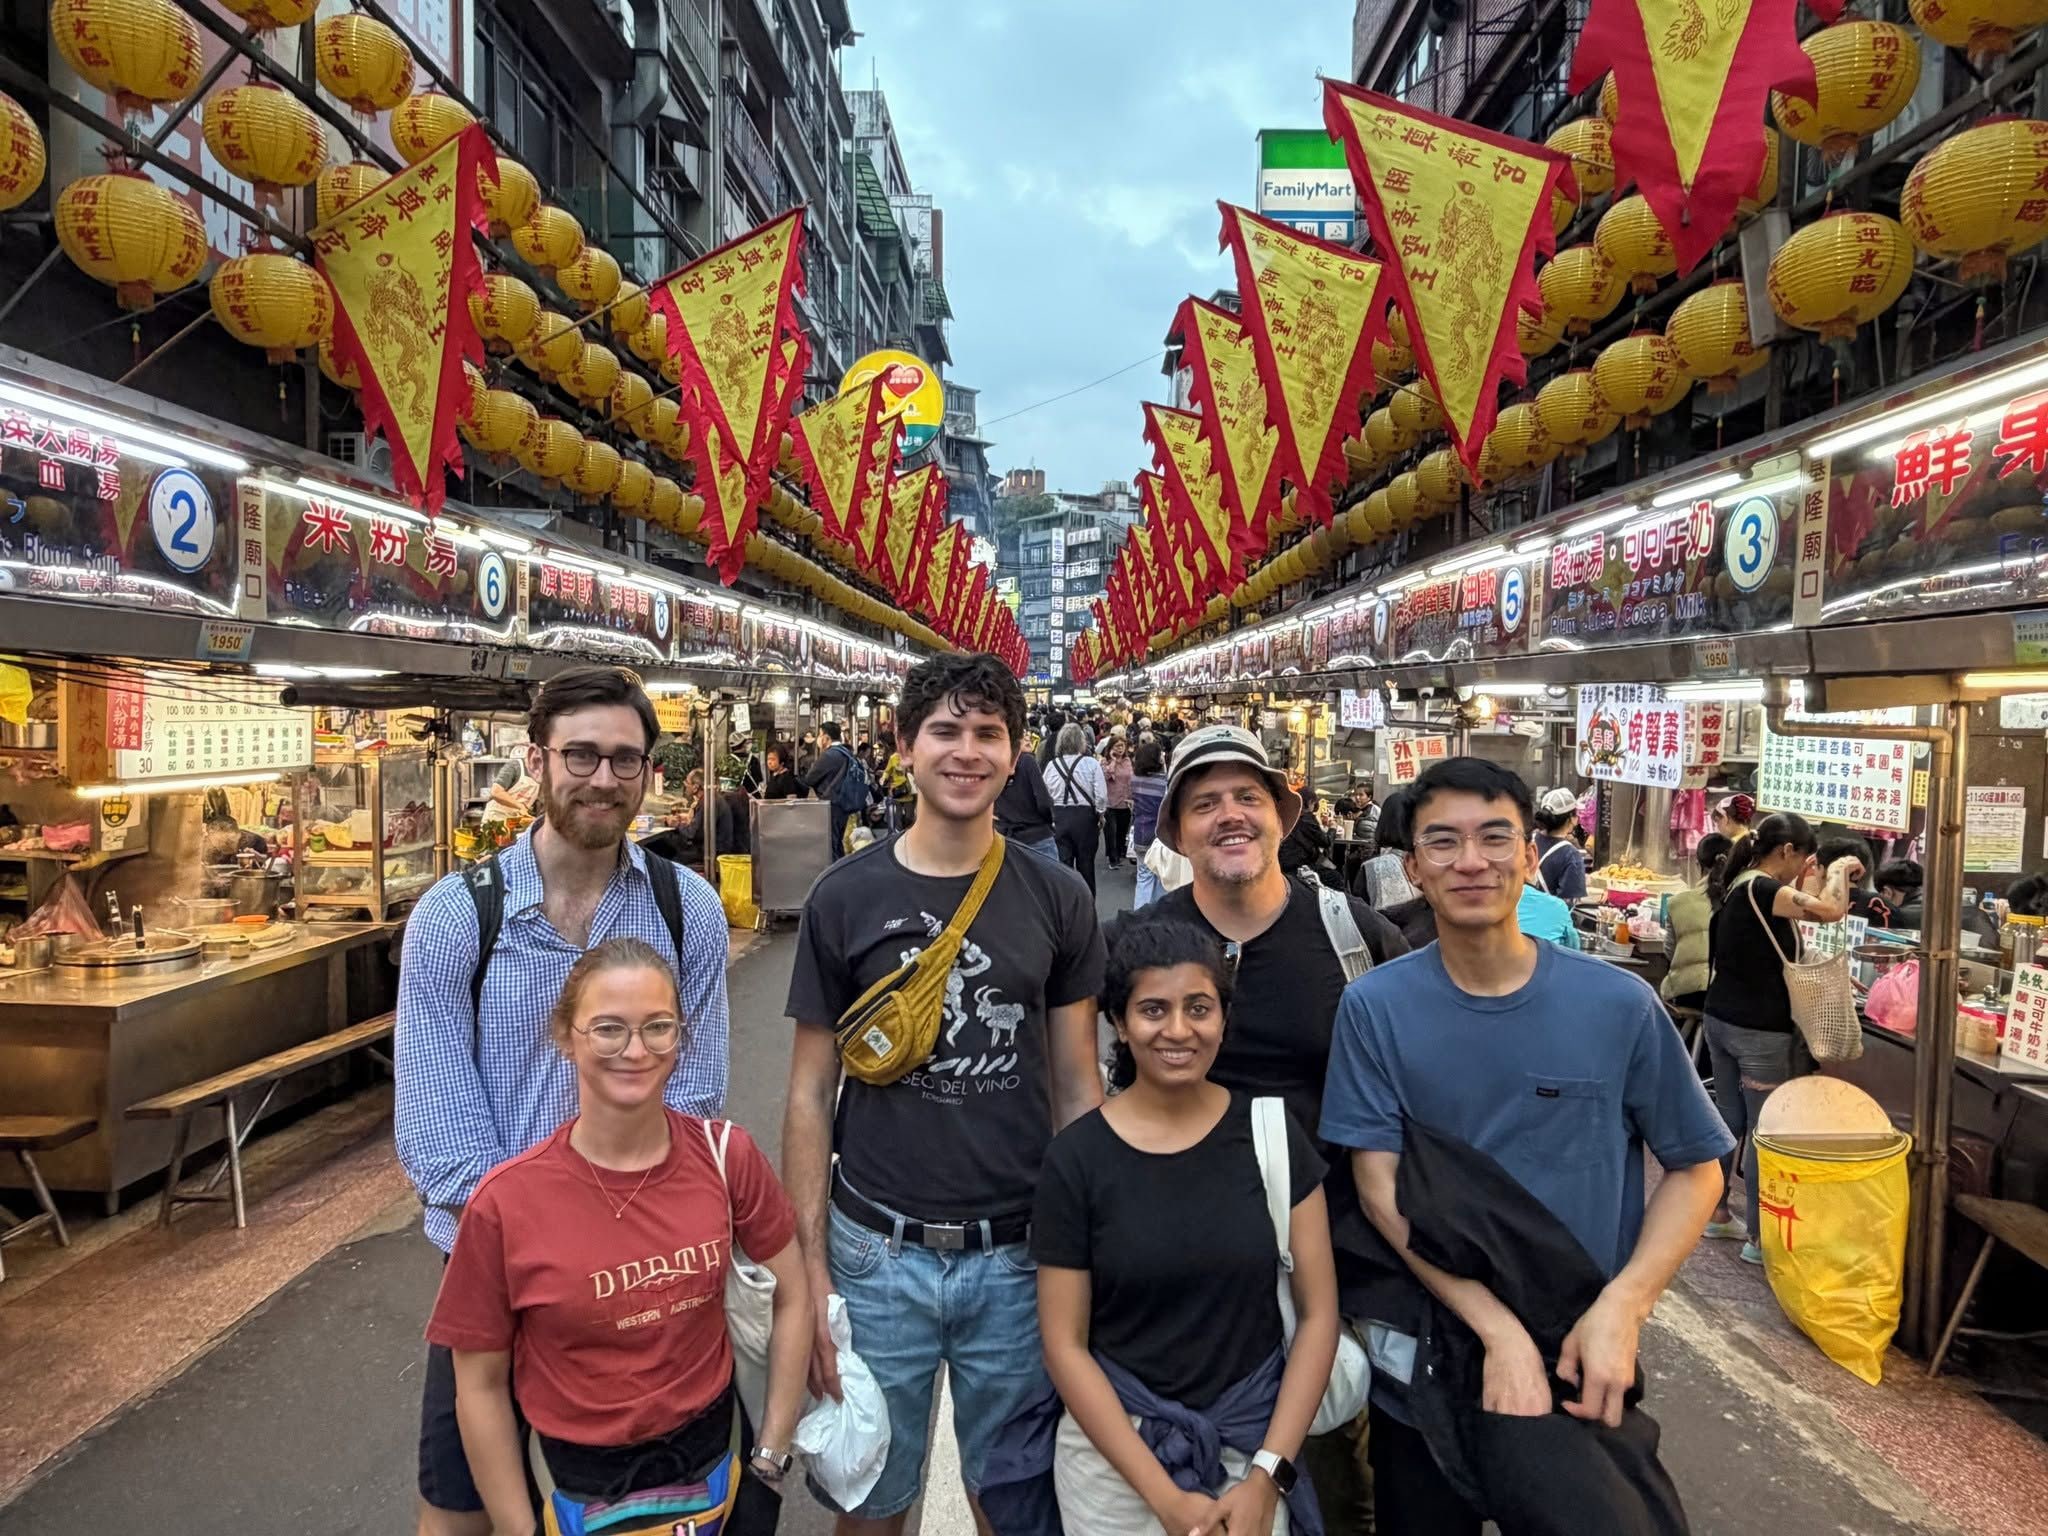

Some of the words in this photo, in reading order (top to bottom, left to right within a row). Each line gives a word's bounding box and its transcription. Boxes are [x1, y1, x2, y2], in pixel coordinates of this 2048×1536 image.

[1263, 181, 1352, 200] FamilyMart
[170, 489, 199, 554] 2
[302, 496, 459, 578] 米粉湯
[1738, 513, 1762, 573] 3
[486, 566, 500, 607] 6
[1505, 580, 1520, 622] 5
[1705, 654, 1728, 668] 1950
[166, 705, 179, 716] 100
[182, 705, 195, 716] 100
[139, 757, 153, 774] 30
[1393, 740, 1415, 780] 外帶
[1838, 803, 1847, 817] 55
[1850, 804, 1860, 819] 25
[1862, 806, 1872, 821] 25
[1875, 808, 1885, 822] 25
[2009, 990, 2030, 1041] 酸梅湯
[2027, 995, 2047, 1047] 可可牛奶
[2026, 1047, 2039, 1061] 25
[941, 1079, 968, 1096] DEL
[975, 1074, 1021, 1094] VINO
[616, 1308, 661, 1331] WESTERN
